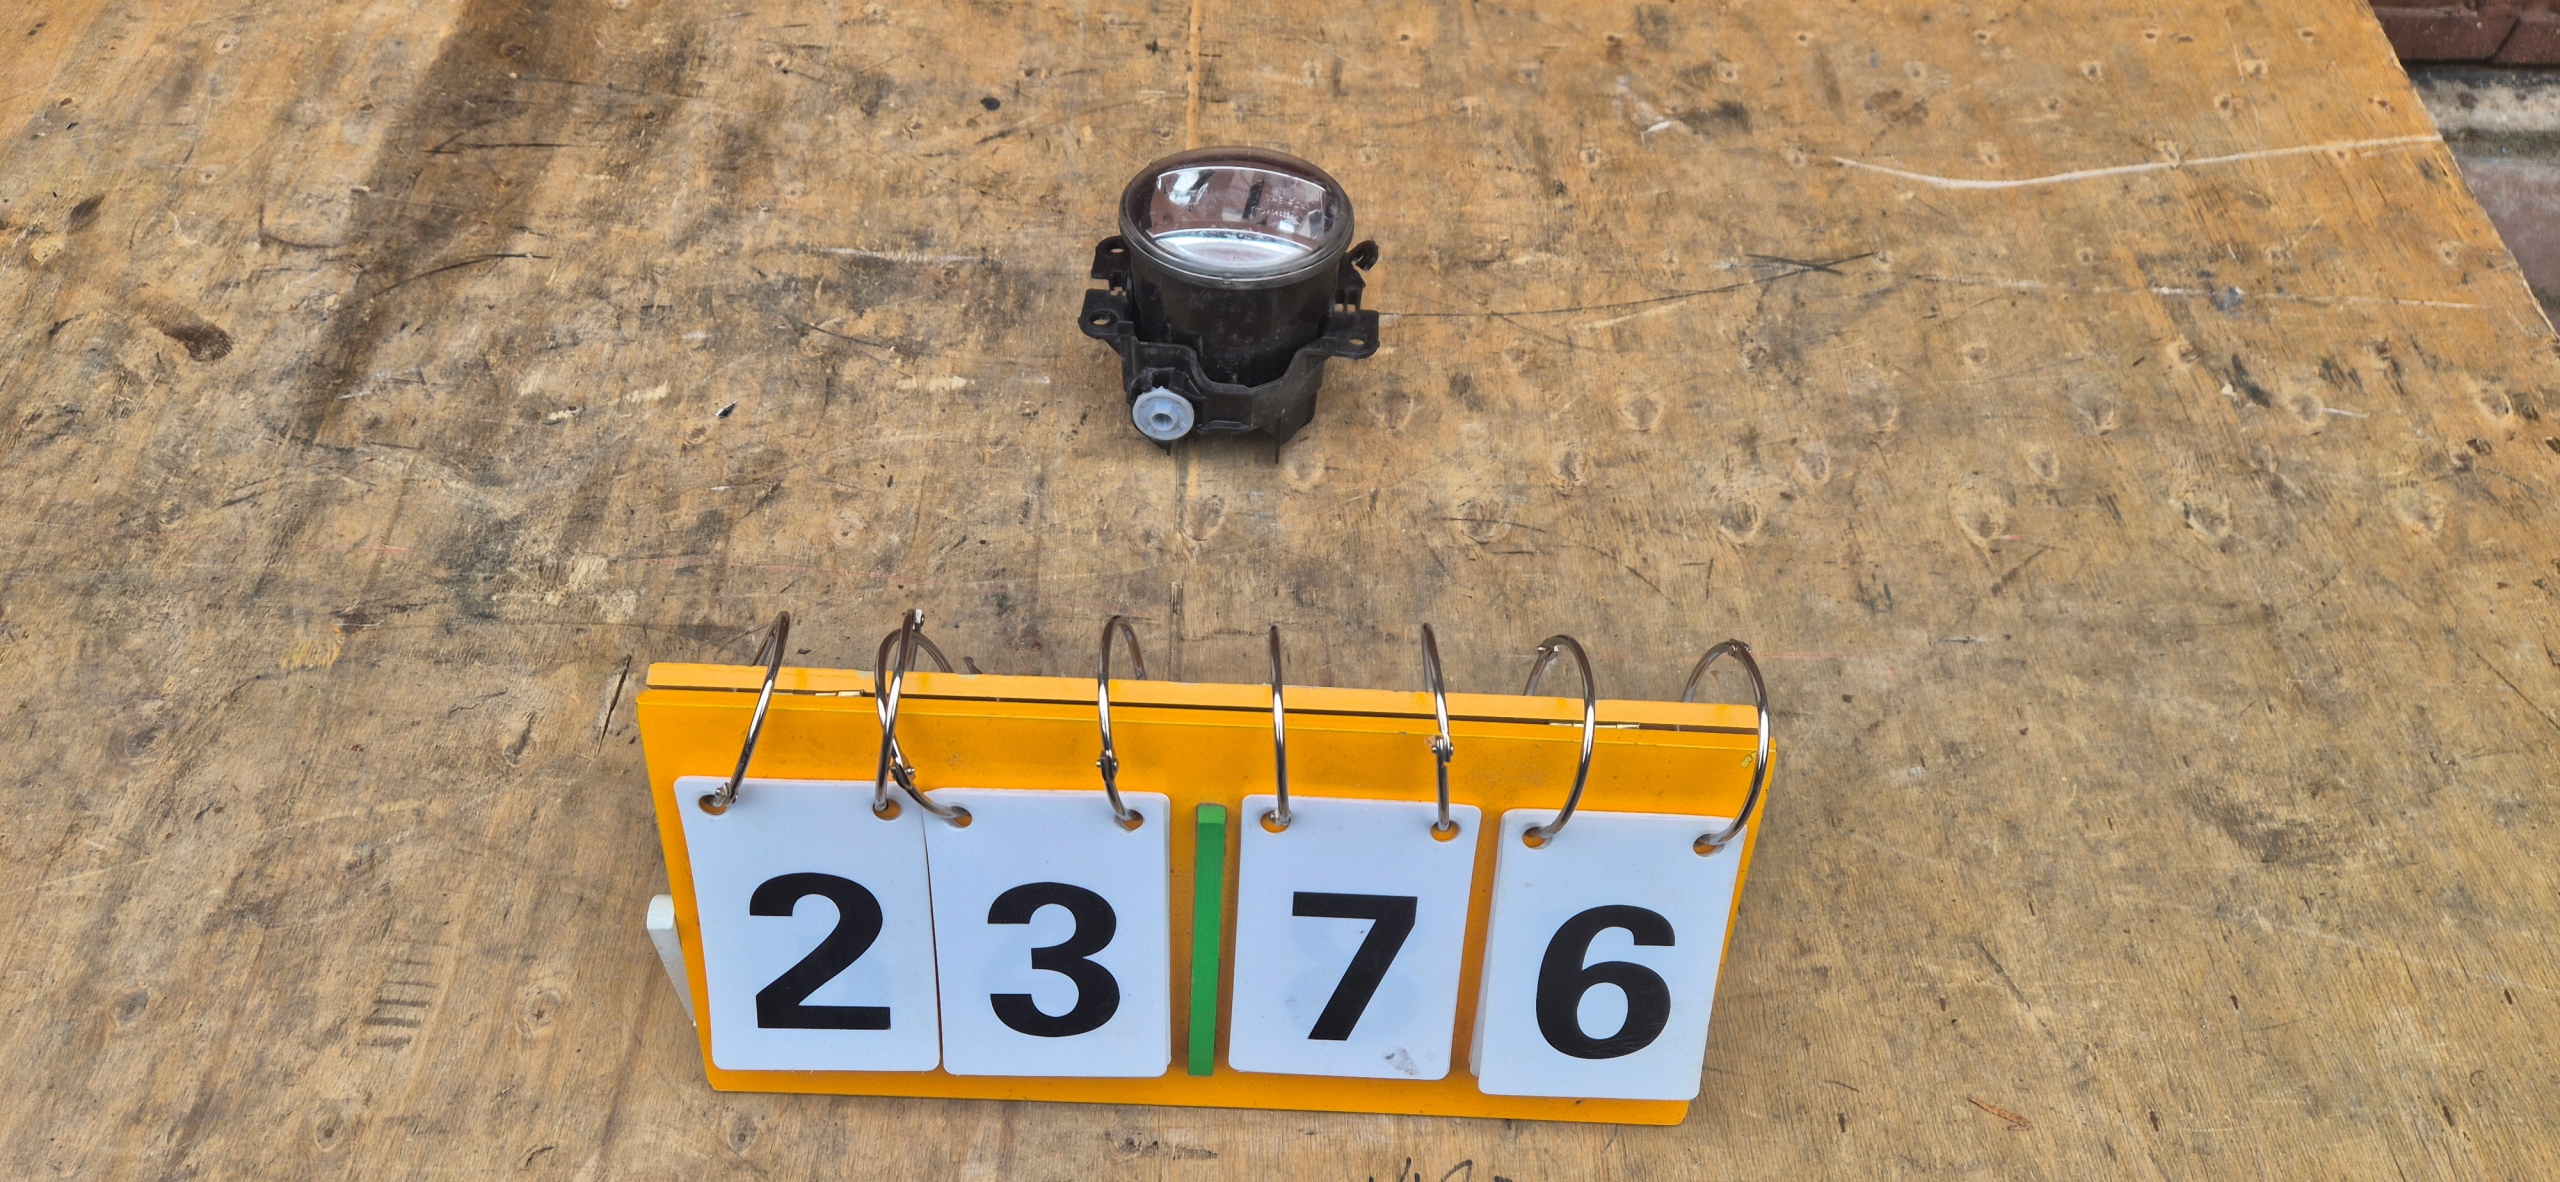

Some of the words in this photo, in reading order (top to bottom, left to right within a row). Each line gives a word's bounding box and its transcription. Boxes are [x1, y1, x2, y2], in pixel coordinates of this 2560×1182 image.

[749, 872, 891, 1030] 2
[987, 881, 1121, 1038] 3
[1292, 891, 1418, 1041] 7
[1535, 904, 1675, 1060] 6
